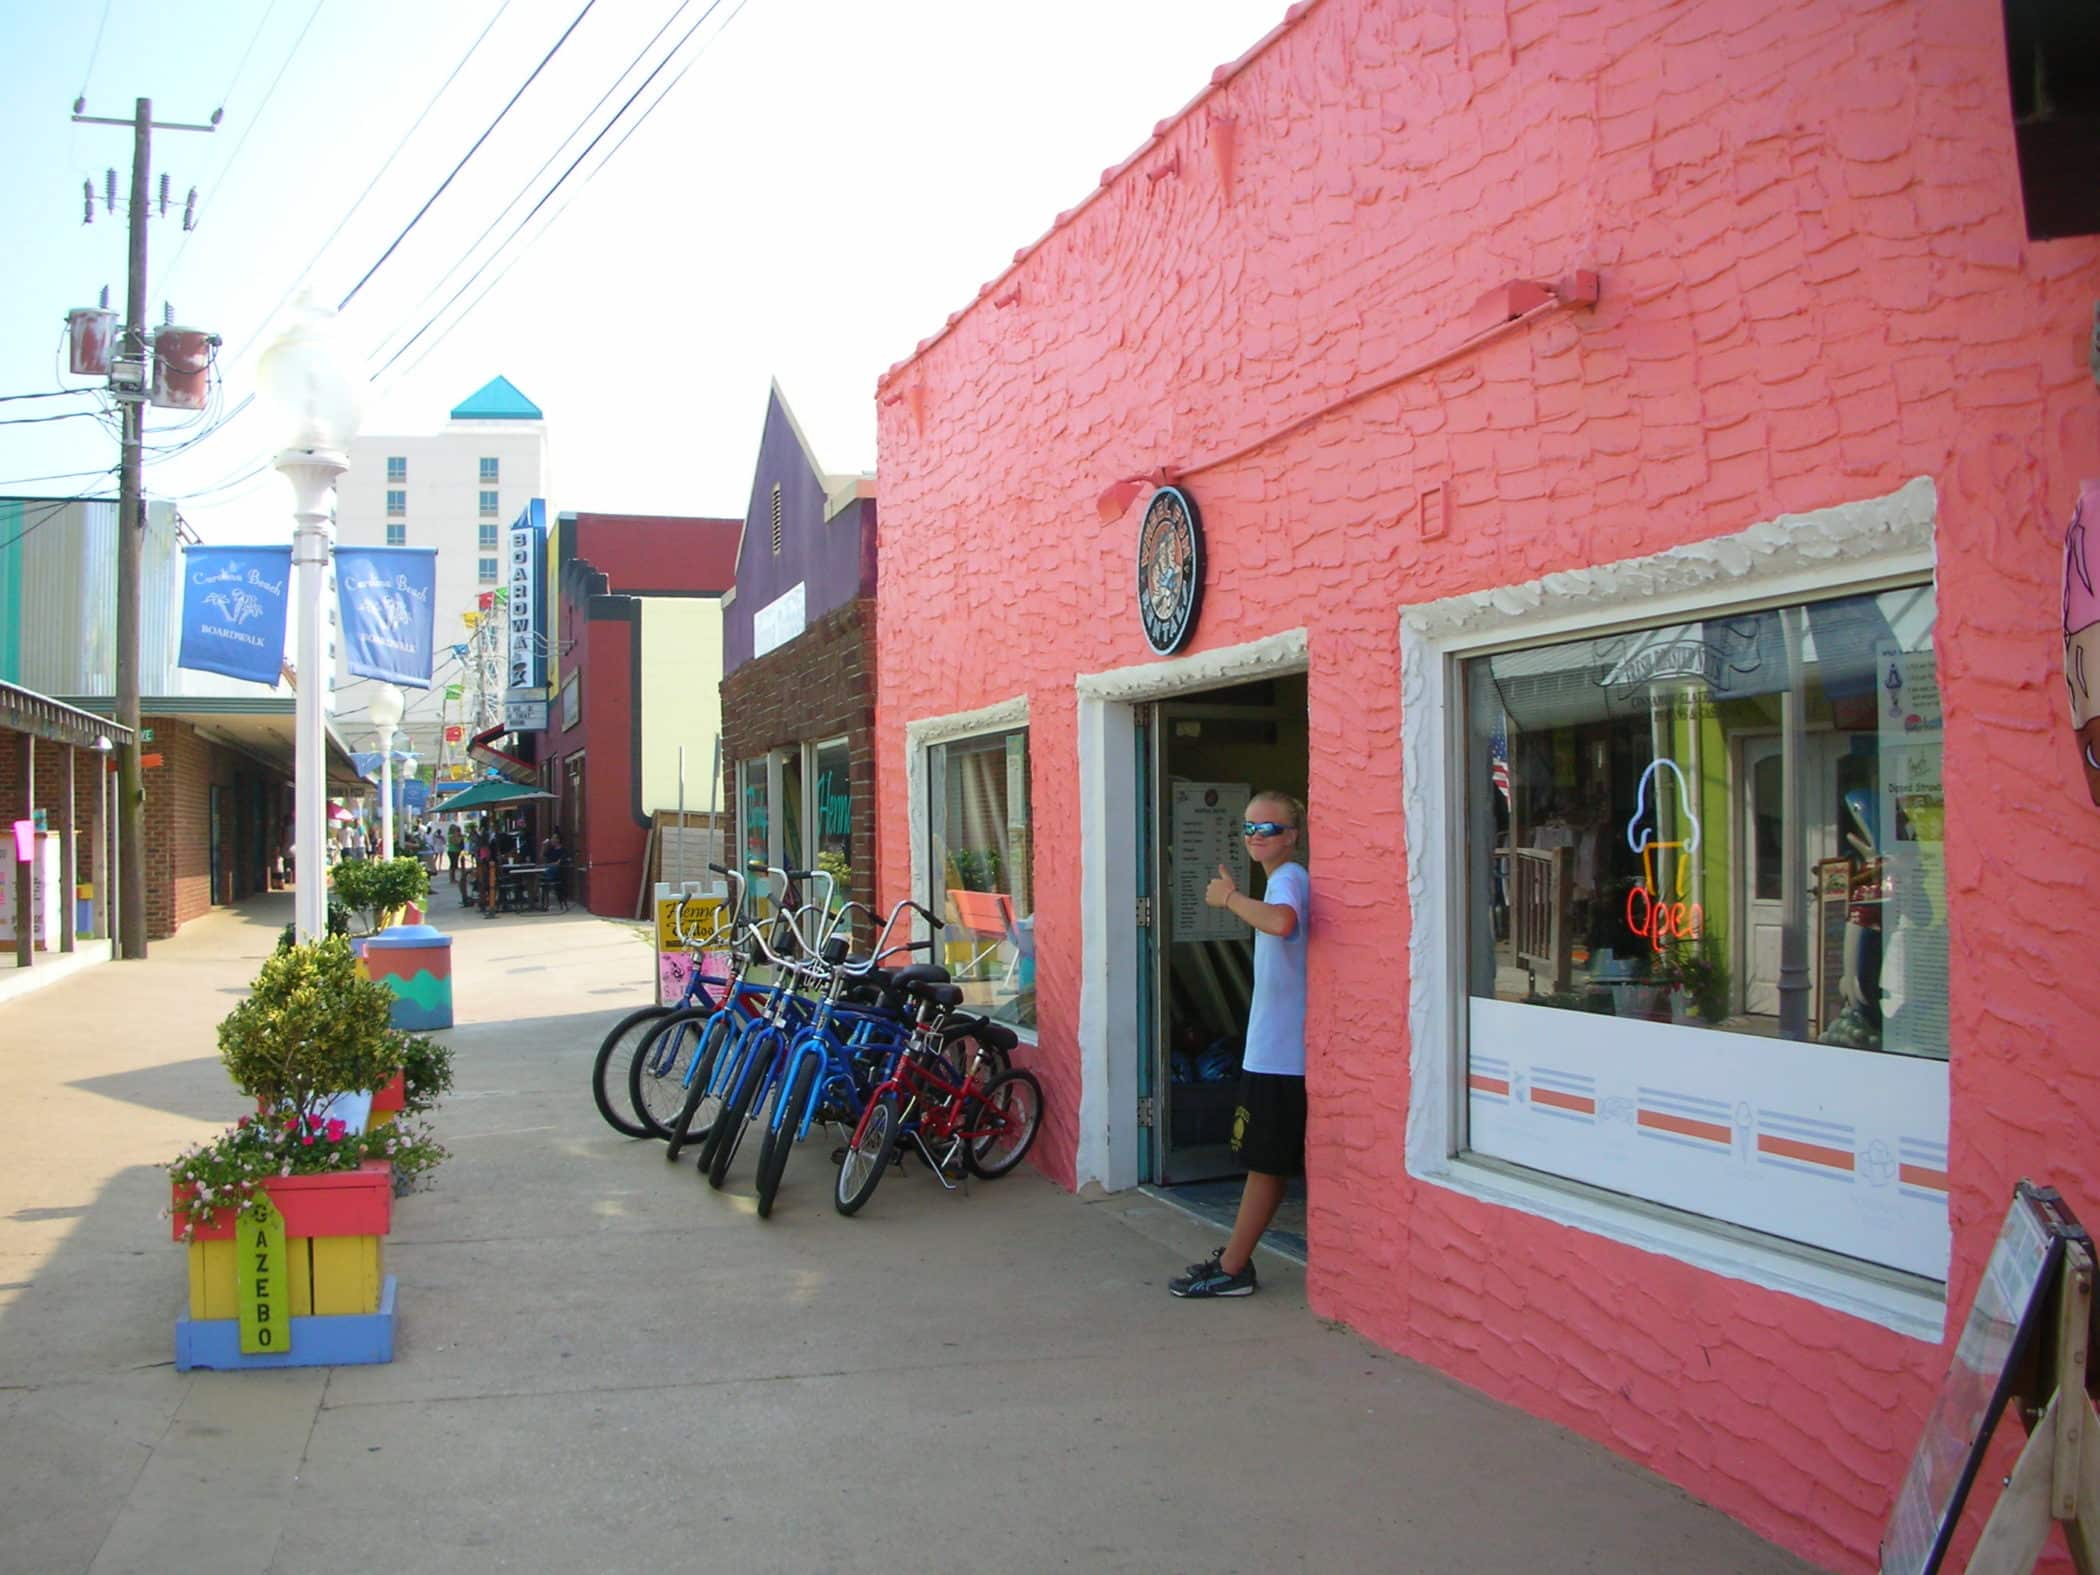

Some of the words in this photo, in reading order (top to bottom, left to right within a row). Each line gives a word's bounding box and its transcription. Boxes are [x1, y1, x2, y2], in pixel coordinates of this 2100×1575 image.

[193, 568, 243, 585] Carolina
[247, 568, 283, 597] Beach
[395, 574, 428, 602] Beach
[201, 623, 265, 648] BOARDWALK
[1626, 886, 1704, 953] Open
[254, 1204, 272, 1346] GAZEBO
